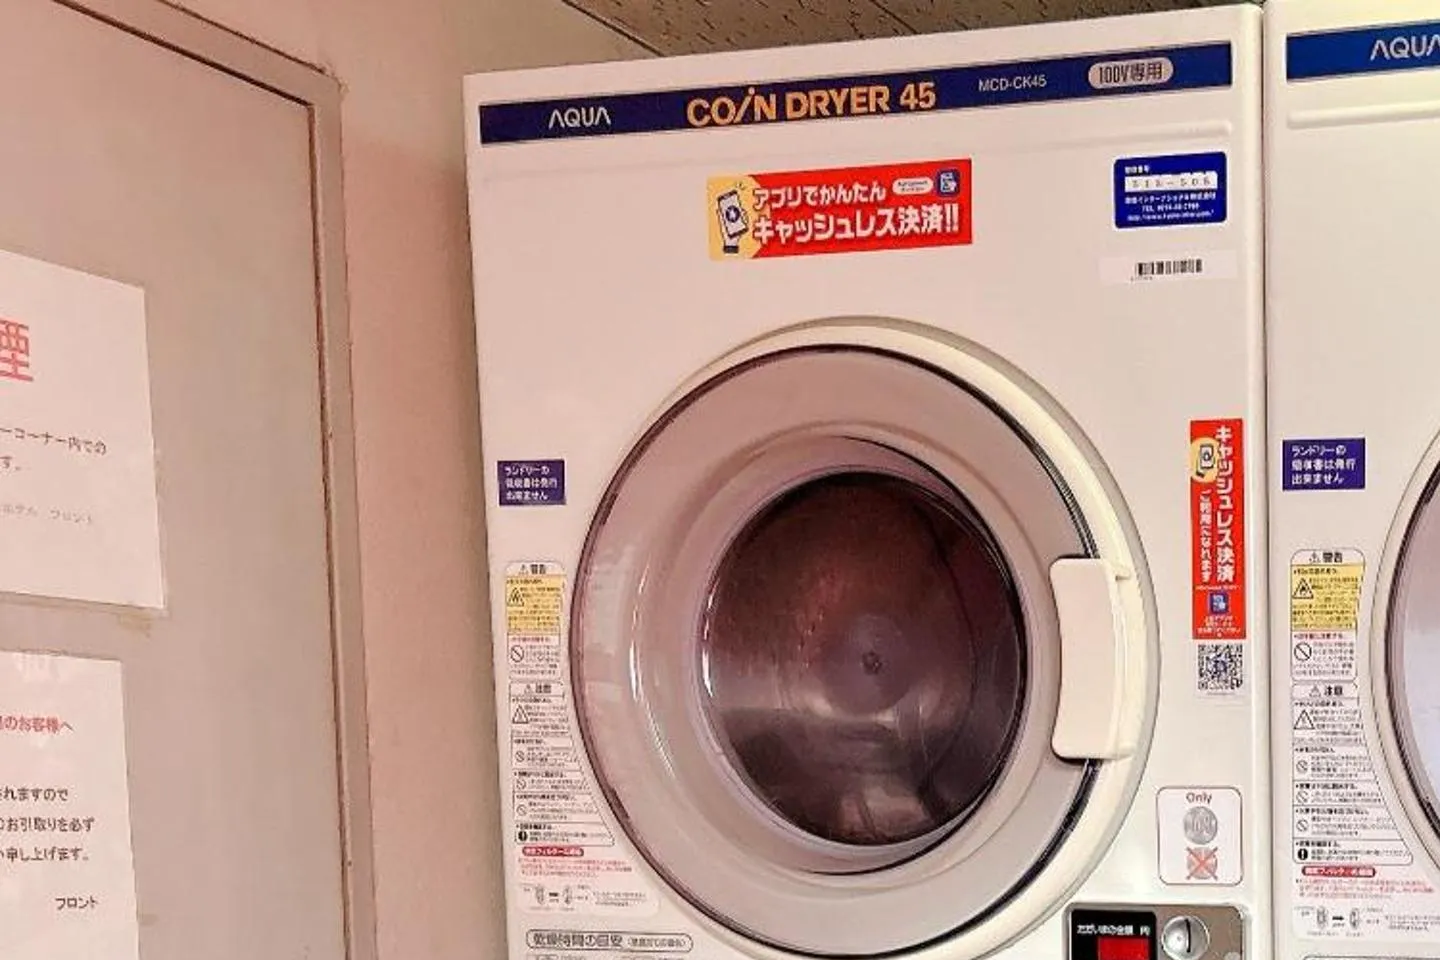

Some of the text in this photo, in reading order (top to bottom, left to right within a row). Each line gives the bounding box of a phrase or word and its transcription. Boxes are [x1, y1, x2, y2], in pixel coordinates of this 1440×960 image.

[1097, 62, 1163, 85] 100V専用
[785, 83, 890, 120] DRYER
[900, 81, 936, 111] 45
[549, 106, 611, 129] AQUA
[752, 181, 887, 209] アプリでかんたん
[753, 203, 960, 246] キャッシュレス決済!!
[1215, 424, 1235, 584] キャッシュレス決済
[1186, 791, 1213, 805] Only
[55, 896, 98, 910] フロント
